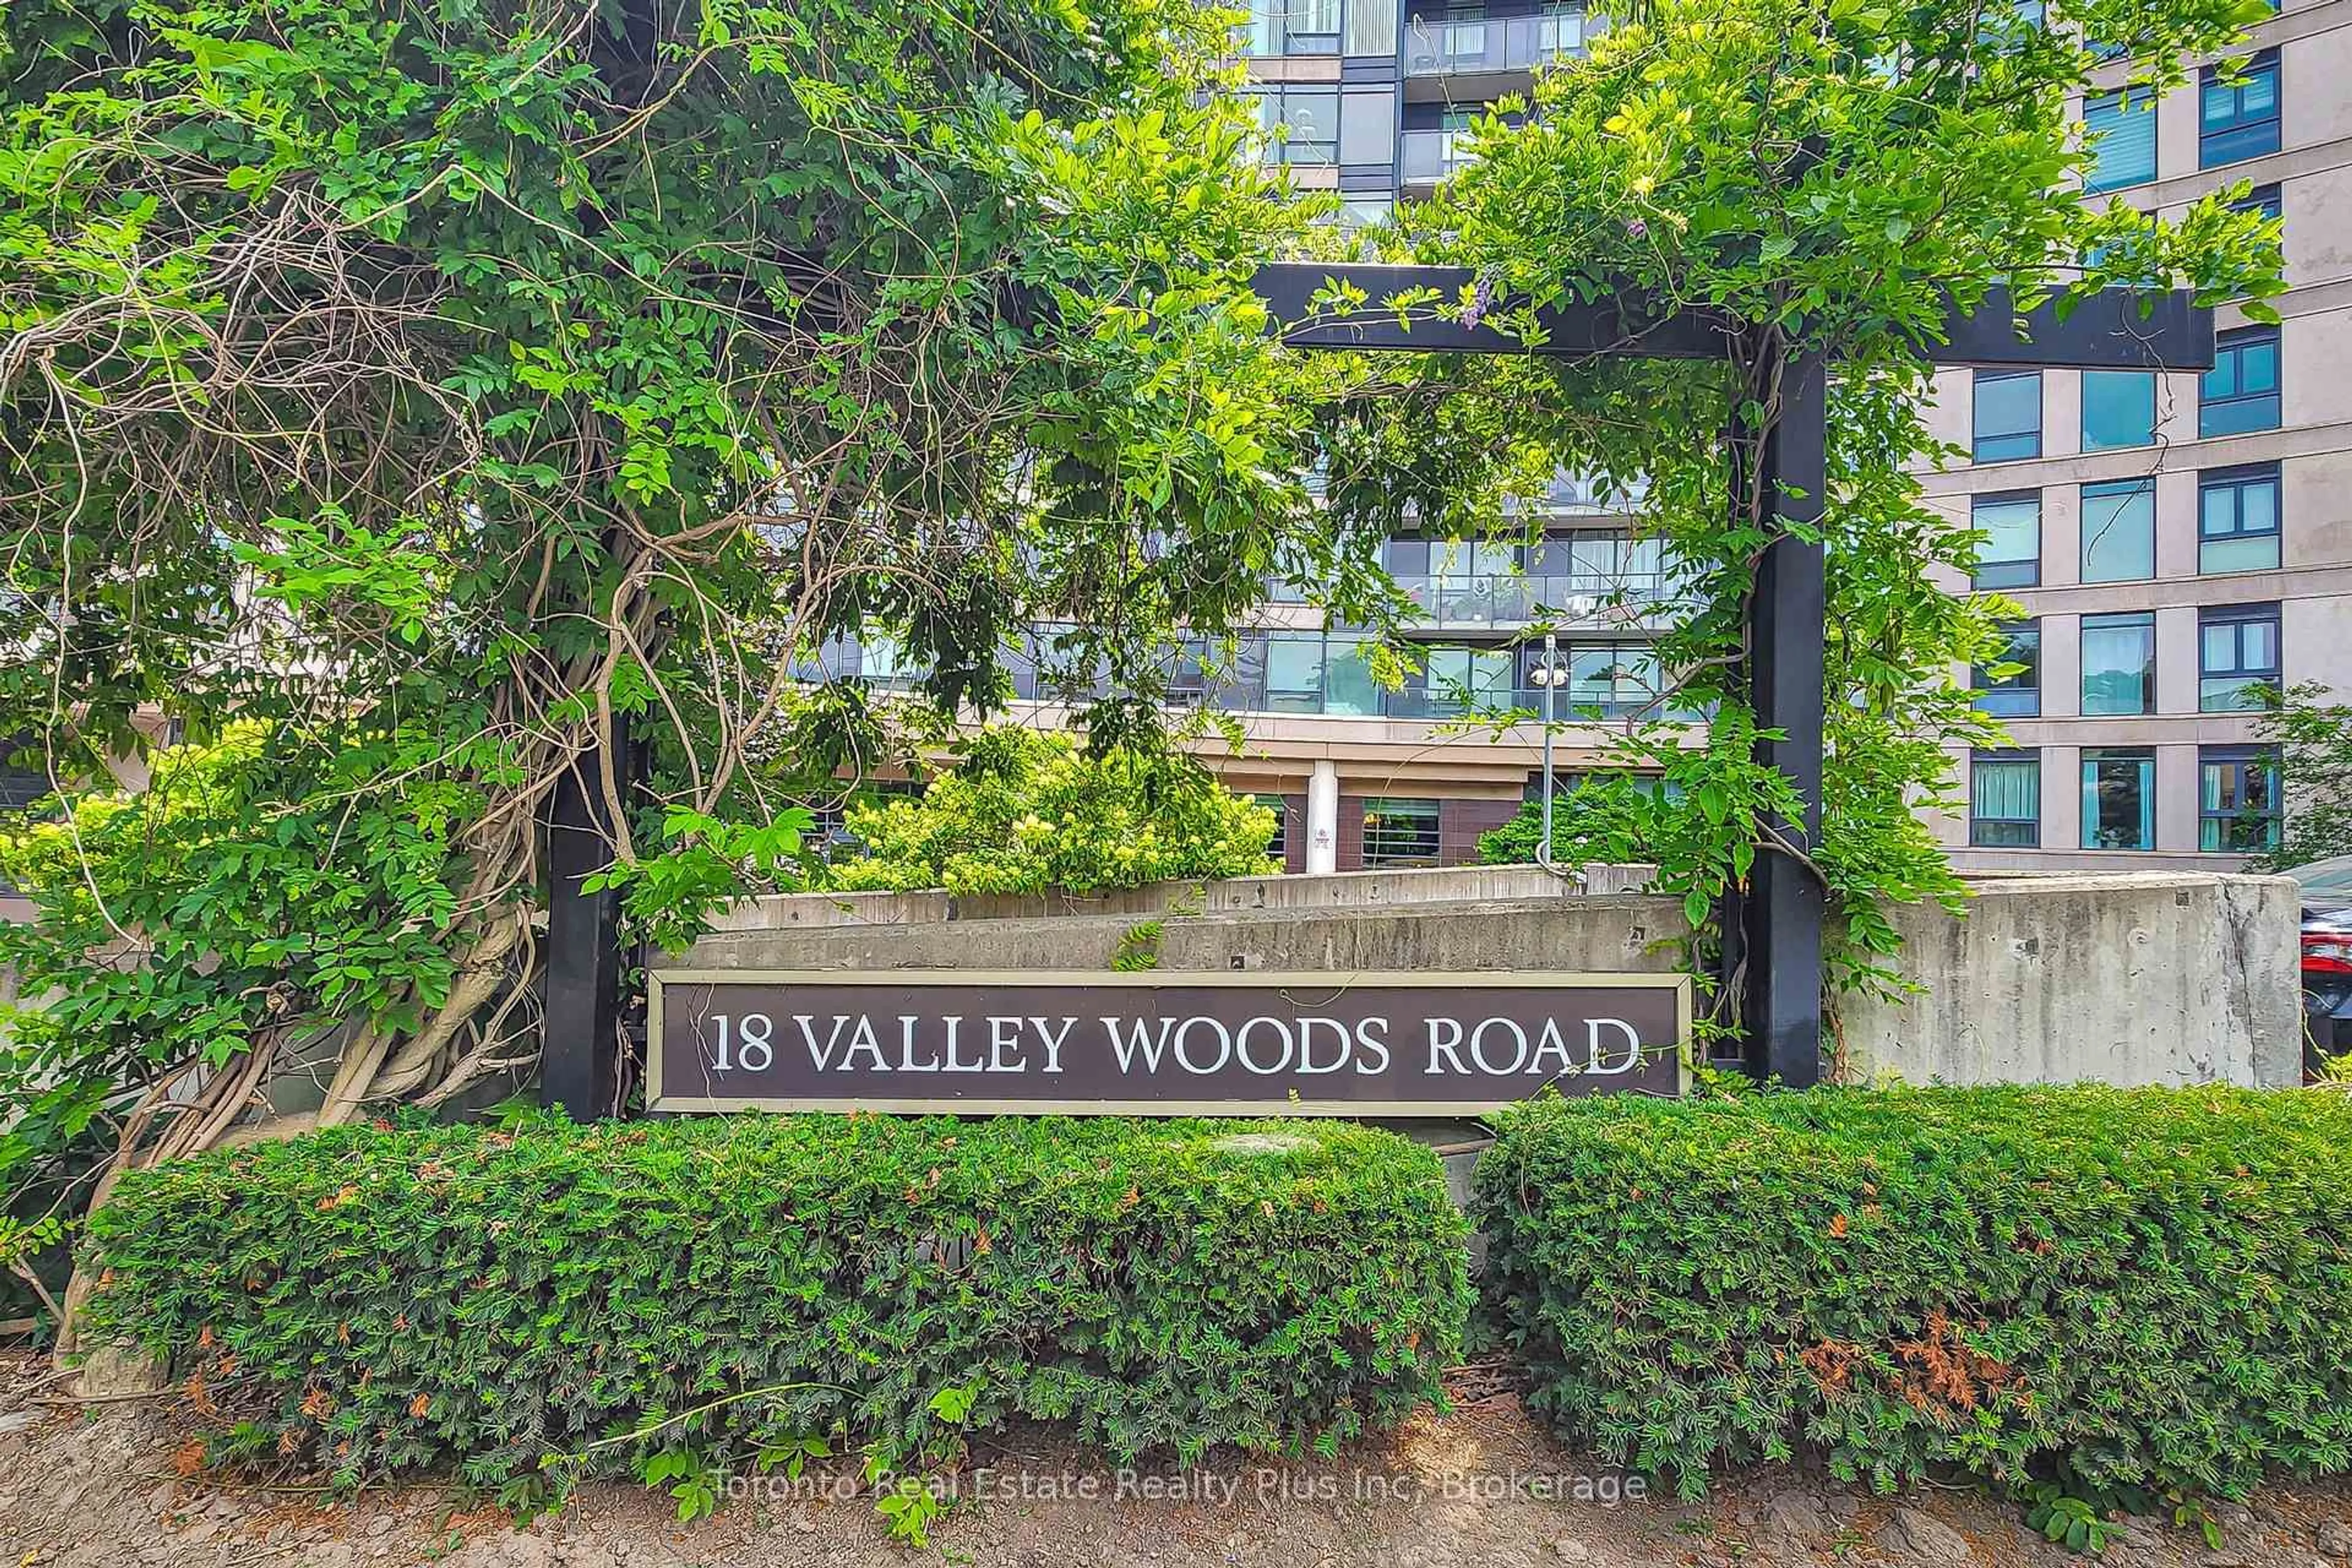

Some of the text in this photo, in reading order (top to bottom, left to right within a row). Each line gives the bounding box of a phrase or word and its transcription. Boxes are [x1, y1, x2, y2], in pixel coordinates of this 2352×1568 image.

[710, 1013, 1642, 1076] 18 VALLEY WOODS ROAD
